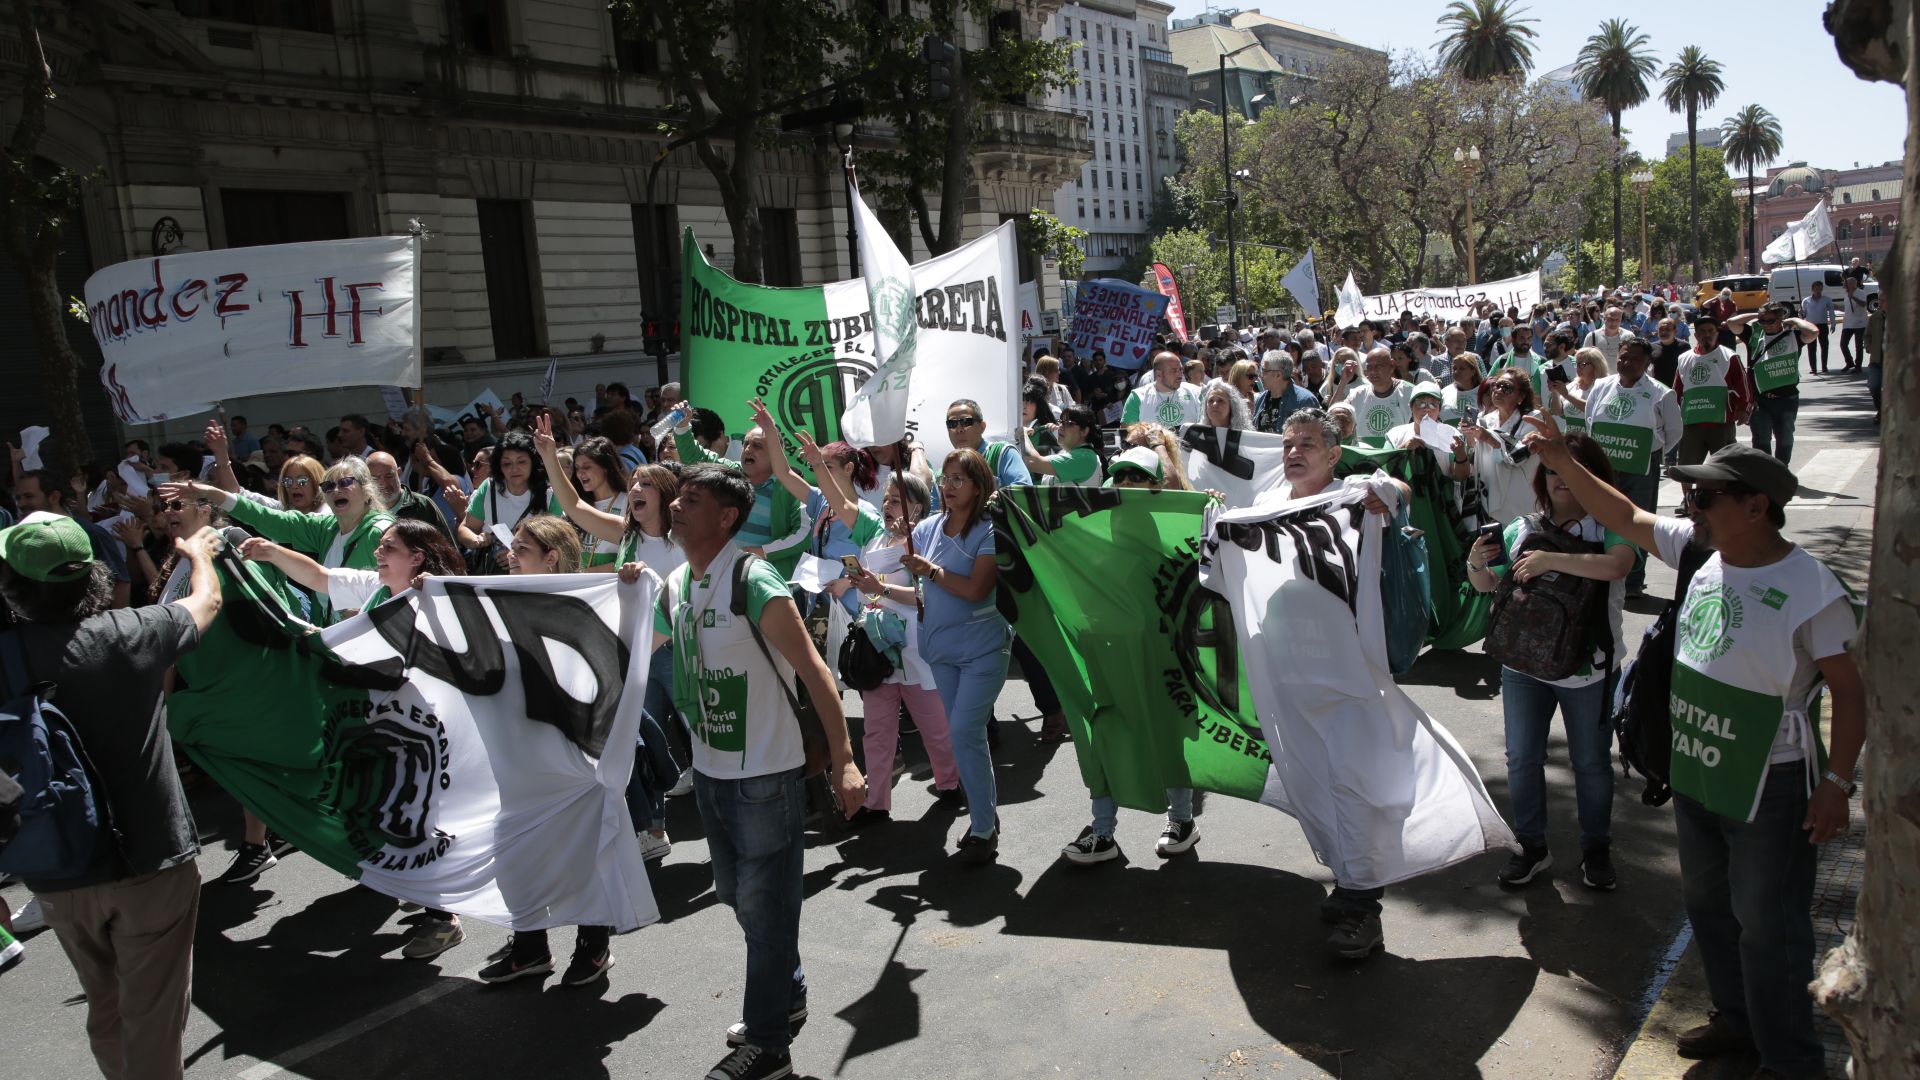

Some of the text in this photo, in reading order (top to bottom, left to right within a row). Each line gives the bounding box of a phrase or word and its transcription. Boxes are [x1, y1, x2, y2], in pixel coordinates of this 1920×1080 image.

[1087, 285, 1142, 310] SOMOS
[1402, 288, 1487, 312] Fernandez
[690, 276, 799, 347] HOSPITAL
[804, 275, 1007, 347] ZUBIRRETA
[844, 341, 866, 354] EL
[1764, 359, 1788, 372] CUERPO
[1161, 405, 1180, 420] ATE
[1371, 411, 1389, 430] ATE
[1594, 433, 1639, 449] HOSPITAL
[1730, 595, 1744, 629] ESTADO
[1163, 667, 1197, 719] PARA
[1670, 693, 1737, 740] SPITAL
[408, 704, 452, 791] ESTADO
[1672, 727, 1722, 768] YANO
